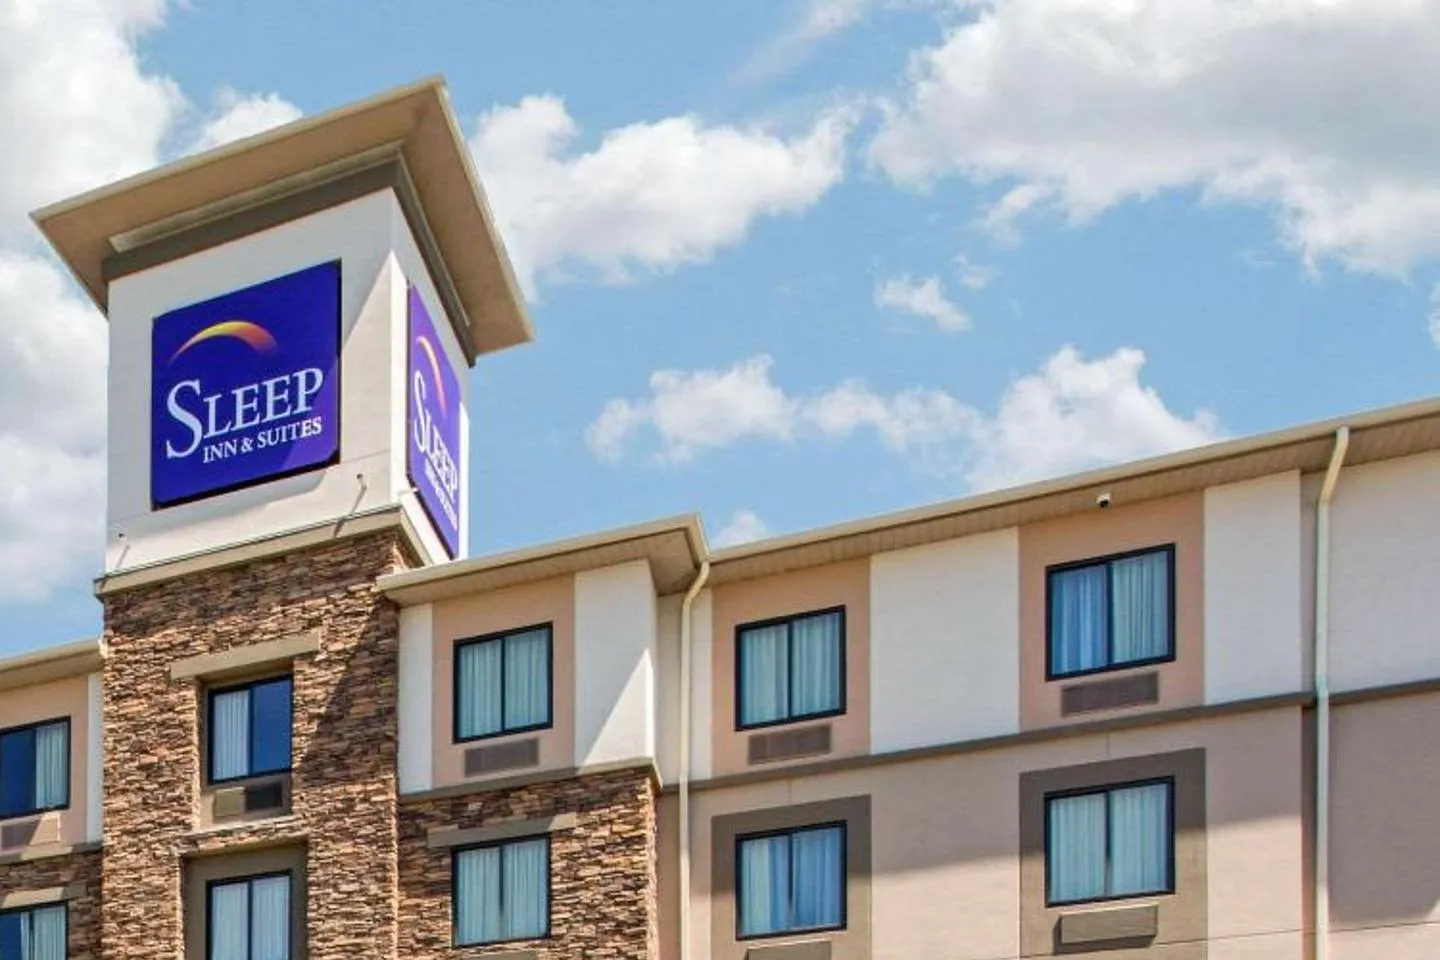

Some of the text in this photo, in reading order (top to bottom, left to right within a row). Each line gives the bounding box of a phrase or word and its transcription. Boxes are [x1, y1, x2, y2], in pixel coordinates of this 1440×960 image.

[166, 368, 323, 459] SLEEP
[203, 416, 323, 463] INN & SUITES
